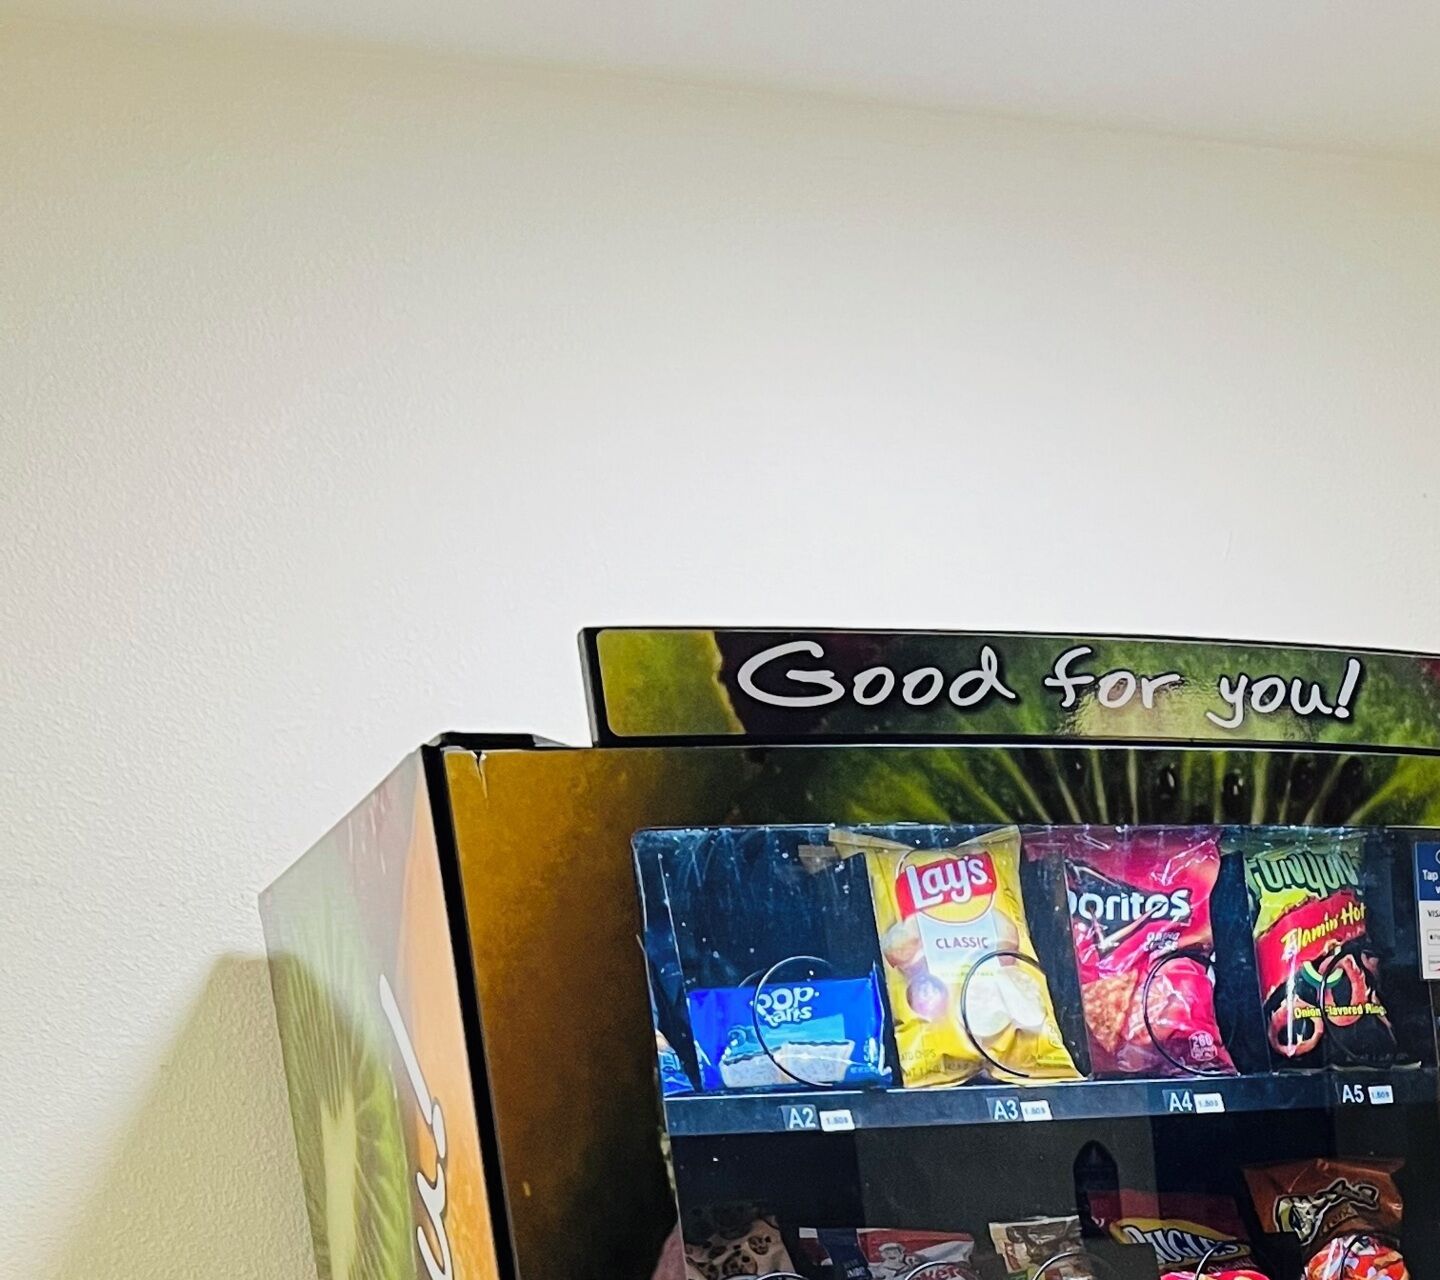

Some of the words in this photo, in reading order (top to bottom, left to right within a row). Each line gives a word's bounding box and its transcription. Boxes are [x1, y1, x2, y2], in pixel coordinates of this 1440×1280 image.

[736, 640, 1017, 710] Good
[1043, 646, 1183, 710] for
[1206, 658, 1360, 729] you!
[906, 856, 990, 909] Lay's
[1422, 869, 1439, 882] Tap
[935, 936, 989, 950] CLASSIC
[1294, 1005, 1322, 1019] Onion
[1169, 1091, 1193, 1112] A4
[1342, 1084, 1365, 1104] A5
[789, 1107, 816, 1129] A2
[994, 1100, 1019, 1120] A3
